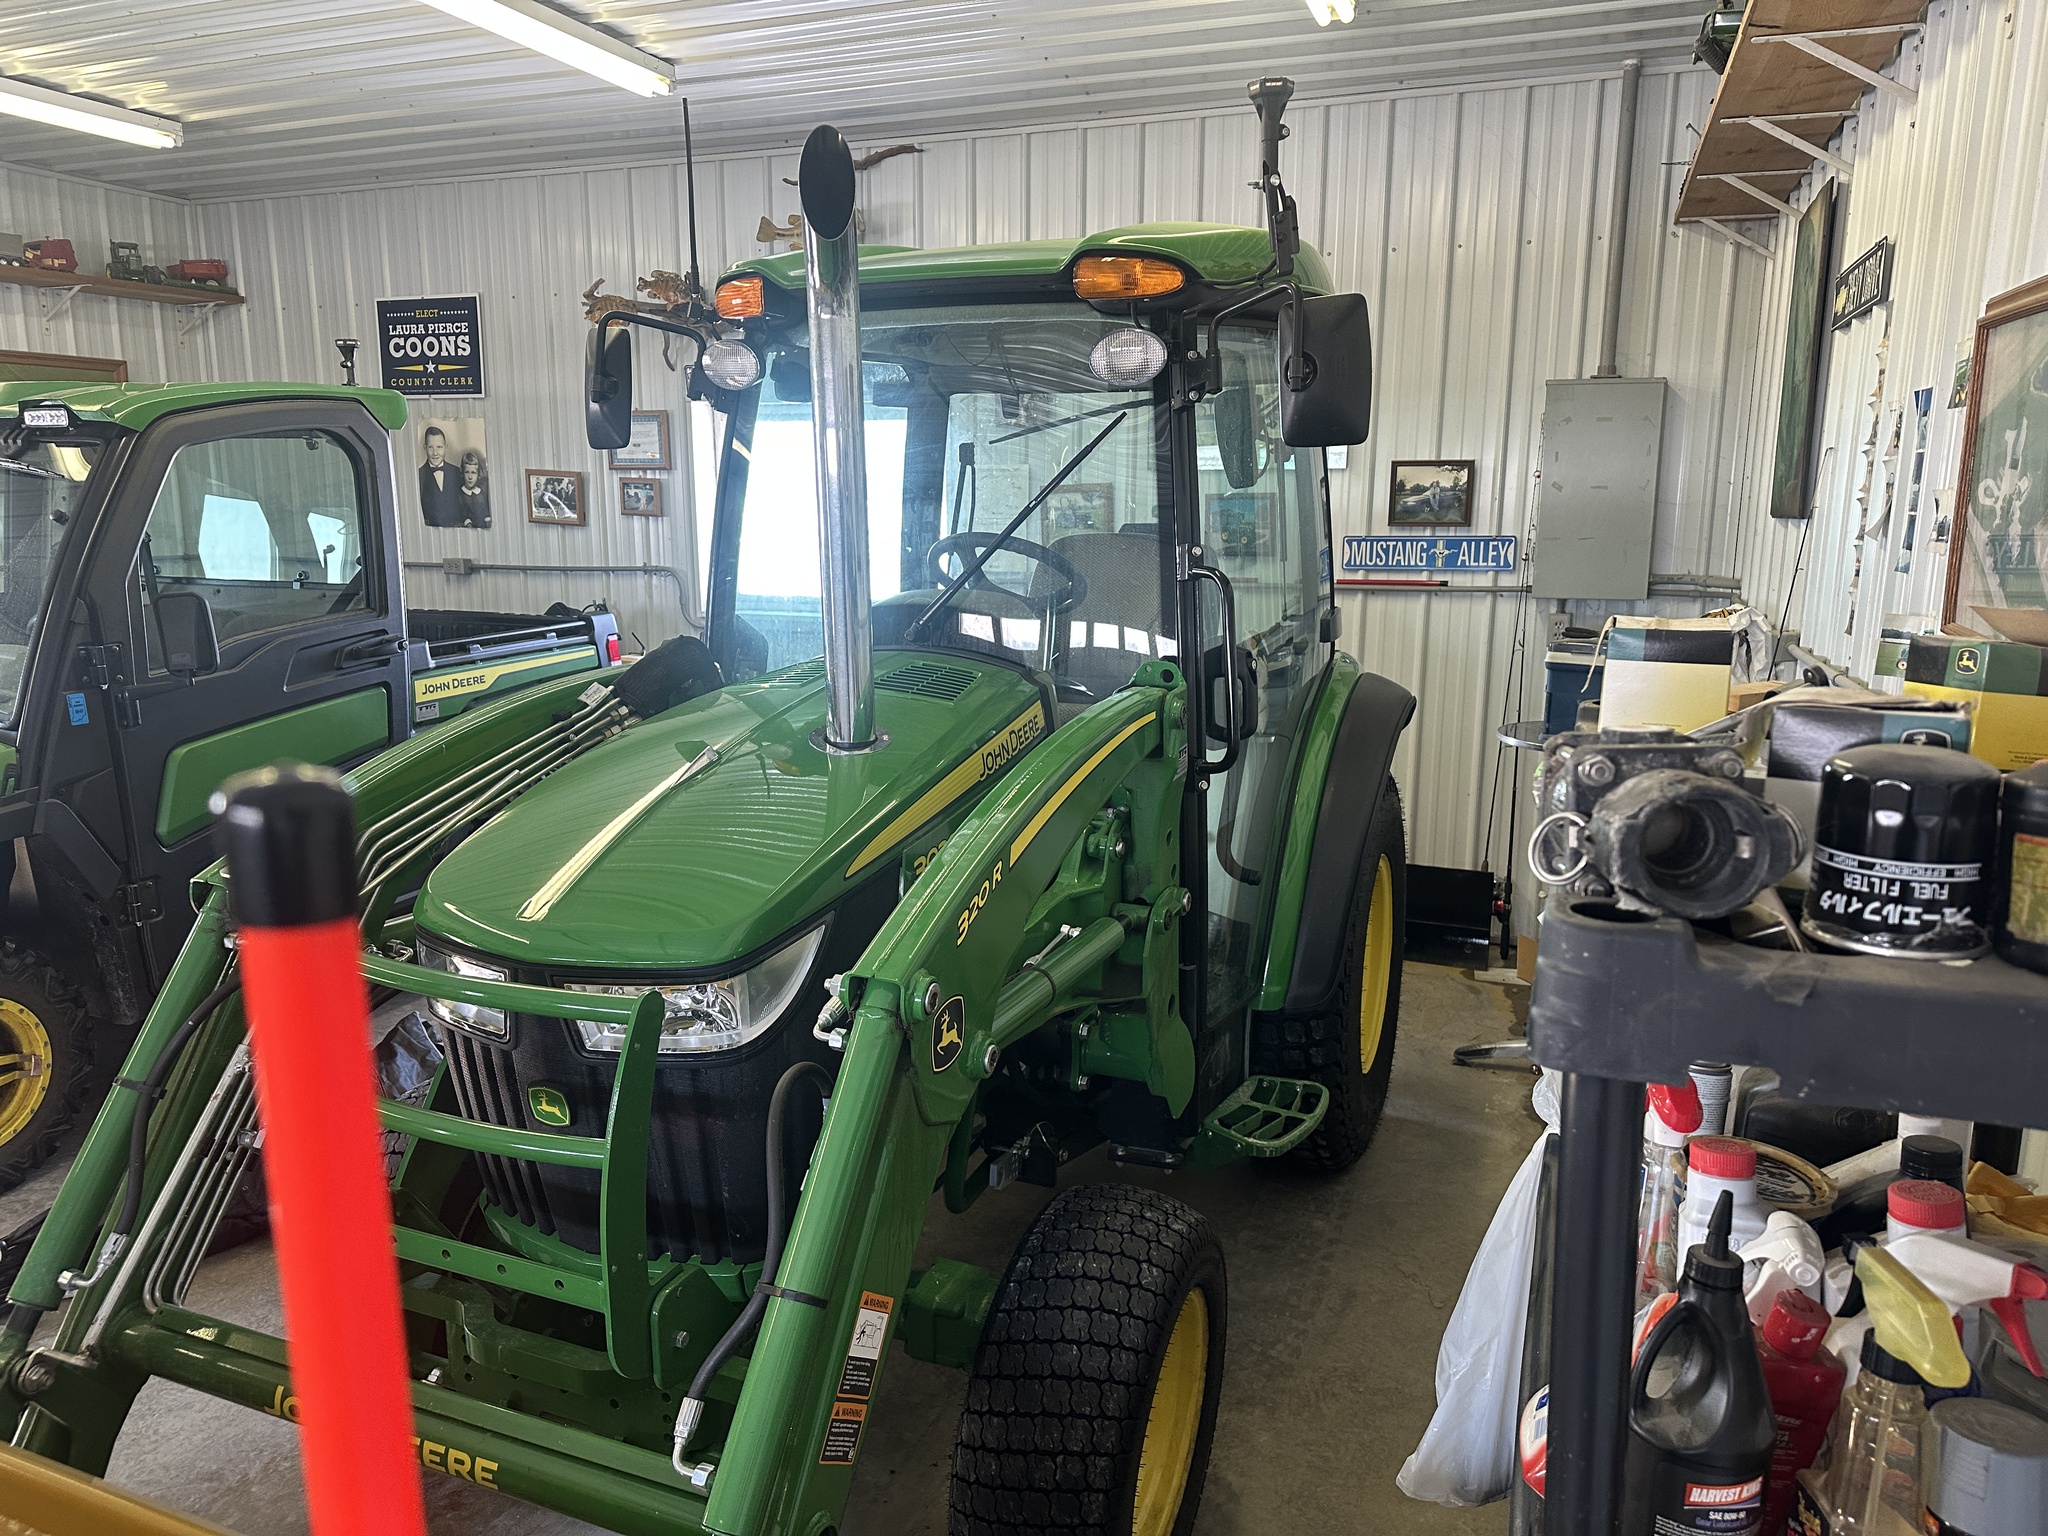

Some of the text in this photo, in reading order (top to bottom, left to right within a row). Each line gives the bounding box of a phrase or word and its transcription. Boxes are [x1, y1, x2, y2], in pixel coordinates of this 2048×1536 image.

[415, 309, 439, 318] ELECT
[388, 322, 469, 335] LAURA PIERCE
[388, 335, 471, 358] COONS
[390, 377, 473, 386] COUNTY CLERK
[1350, 541, 1510, 566] MUSTANG ALLEY
[421, 674, 486, 695] JOHN DEERE
[979, 713, 1040, 780] JOHN DEERE
[1832, 854, 1859, 868] HIGH
[1872, 863, 1947, 878] EFFICIENCY
[1843, 871, 1950, 900] FUEL FILTER
[957, 860, 1003, 947] 320 R
[870, 1298, 890, 1310] WARNING
[263, 1385, 300, 1421] JO
[841, 1407, 863, 1418] WARNING
[1689, 1486, 1742, 1503] HARVEST
[1708, 1510, 1723, 1520] SAE
